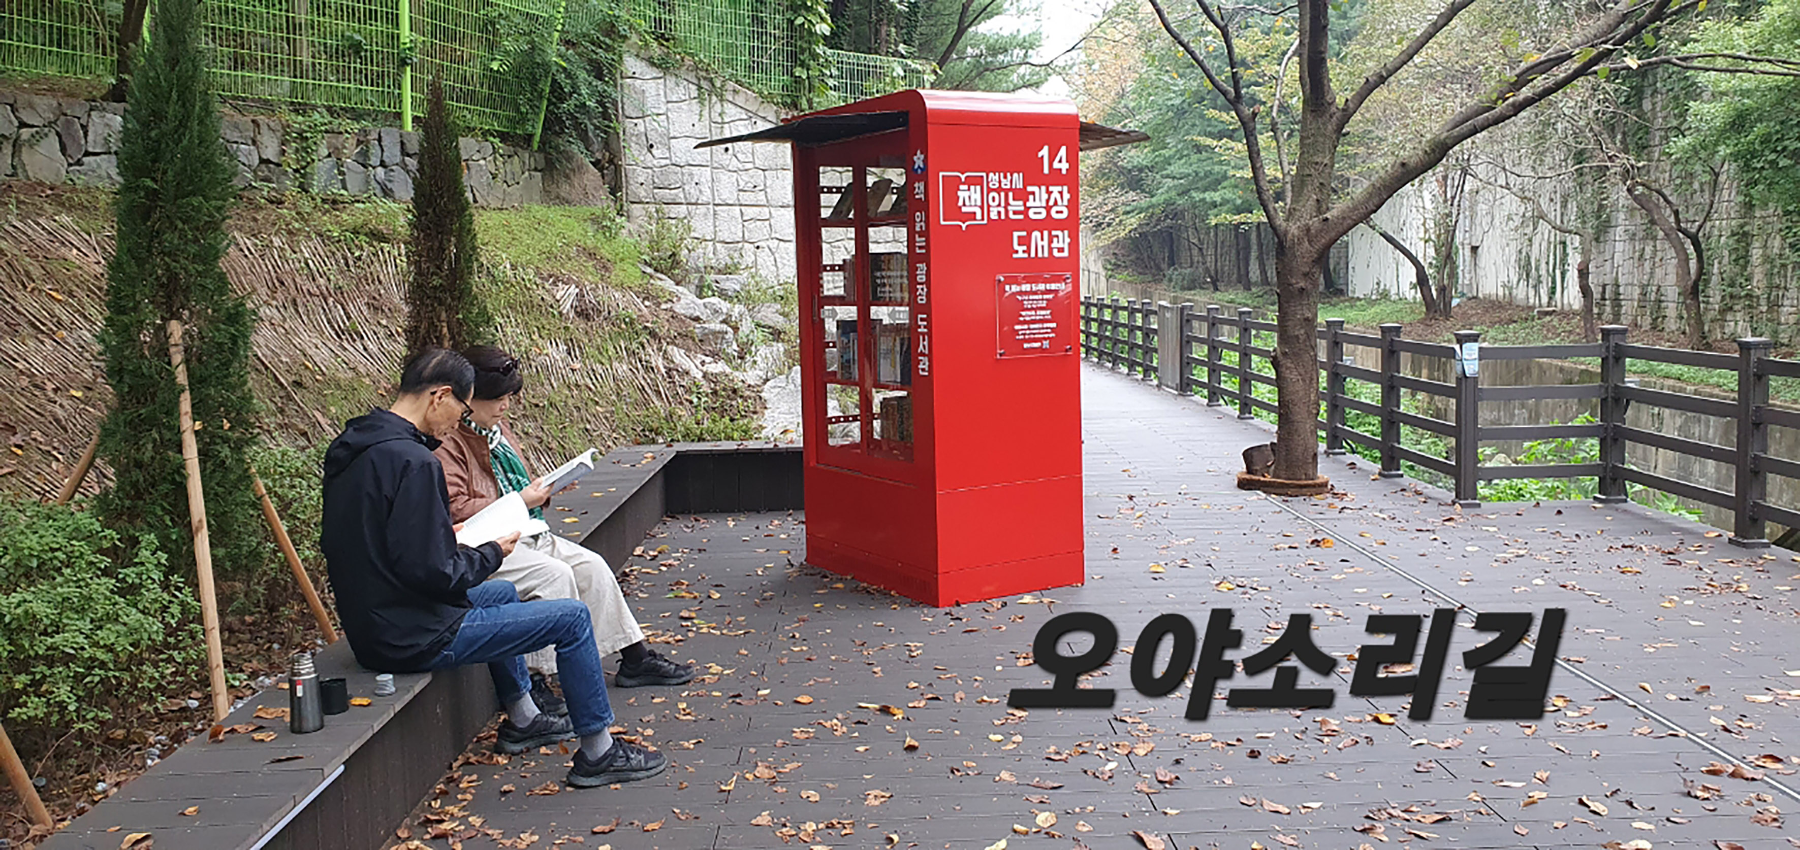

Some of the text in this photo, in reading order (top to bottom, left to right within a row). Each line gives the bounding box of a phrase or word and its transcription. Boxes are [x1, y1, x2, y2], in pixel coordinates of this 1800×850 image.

[1038, 145, 1069, 174] 14
[988, 172, 1023, 188] 성남시
[957, 185, 982, 220] 책
[1012, 230, 1070, 258] 도서관
[914, 181, 929, 376] 책 읽는 광장 도서관
